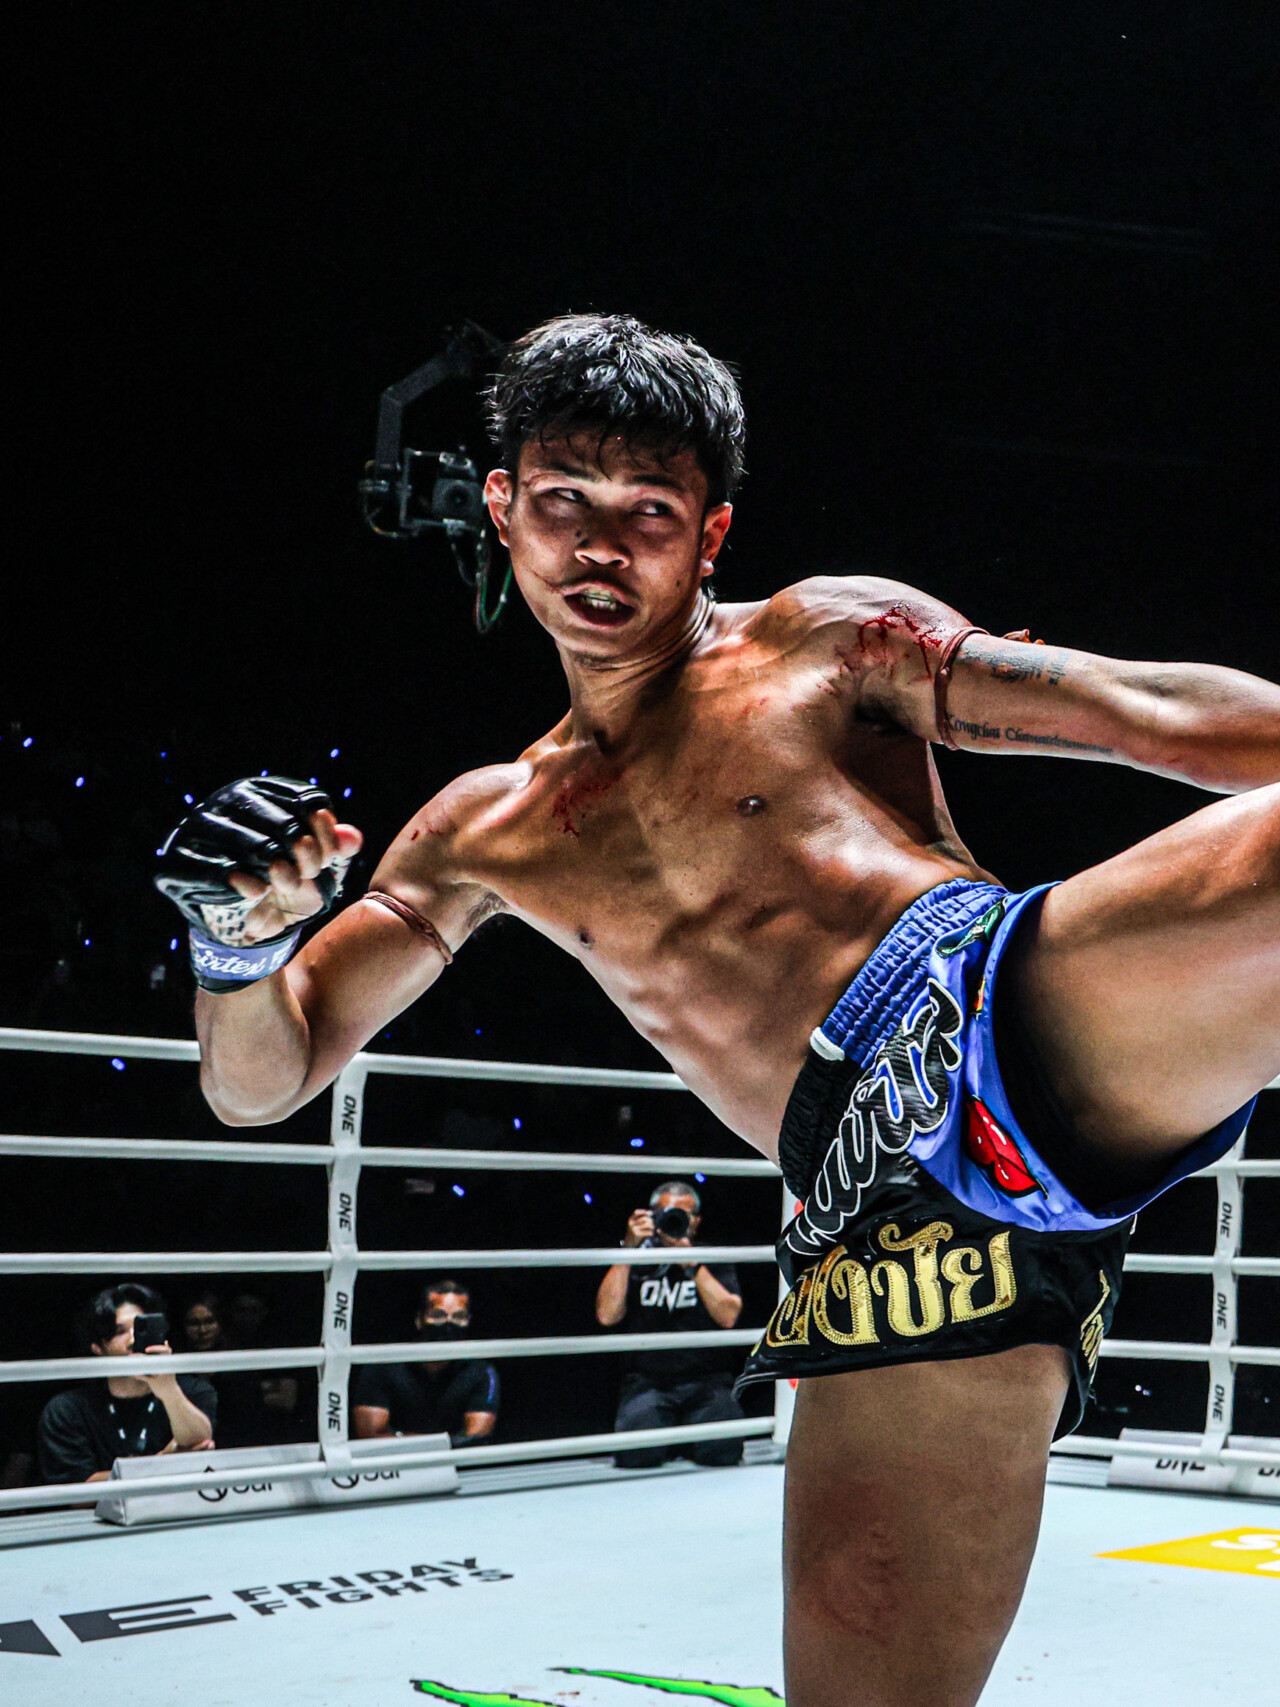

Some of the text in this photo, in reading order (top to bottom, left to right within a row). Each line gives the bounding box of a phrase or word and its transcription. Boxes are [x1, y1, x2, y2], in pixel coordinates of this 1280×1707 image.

[342, 1094, 356, 1135] ONE
[337, 1192, 352, 1232] ONE
[1220, 1202, 1233, 1238] ONE
[332, 1291, 348, 1331] ONE
[640, 1276, 699, 1313] ONE
[1216, 1293, 1228, 1329] ONE
[326, 1391, 341, 1432] ONE
[1212, 1384, 1225, 1422] ONE
[232, 1557, 478, 1602] FRIDAY
[250, 1568, 515, 1616] FIGHTS
